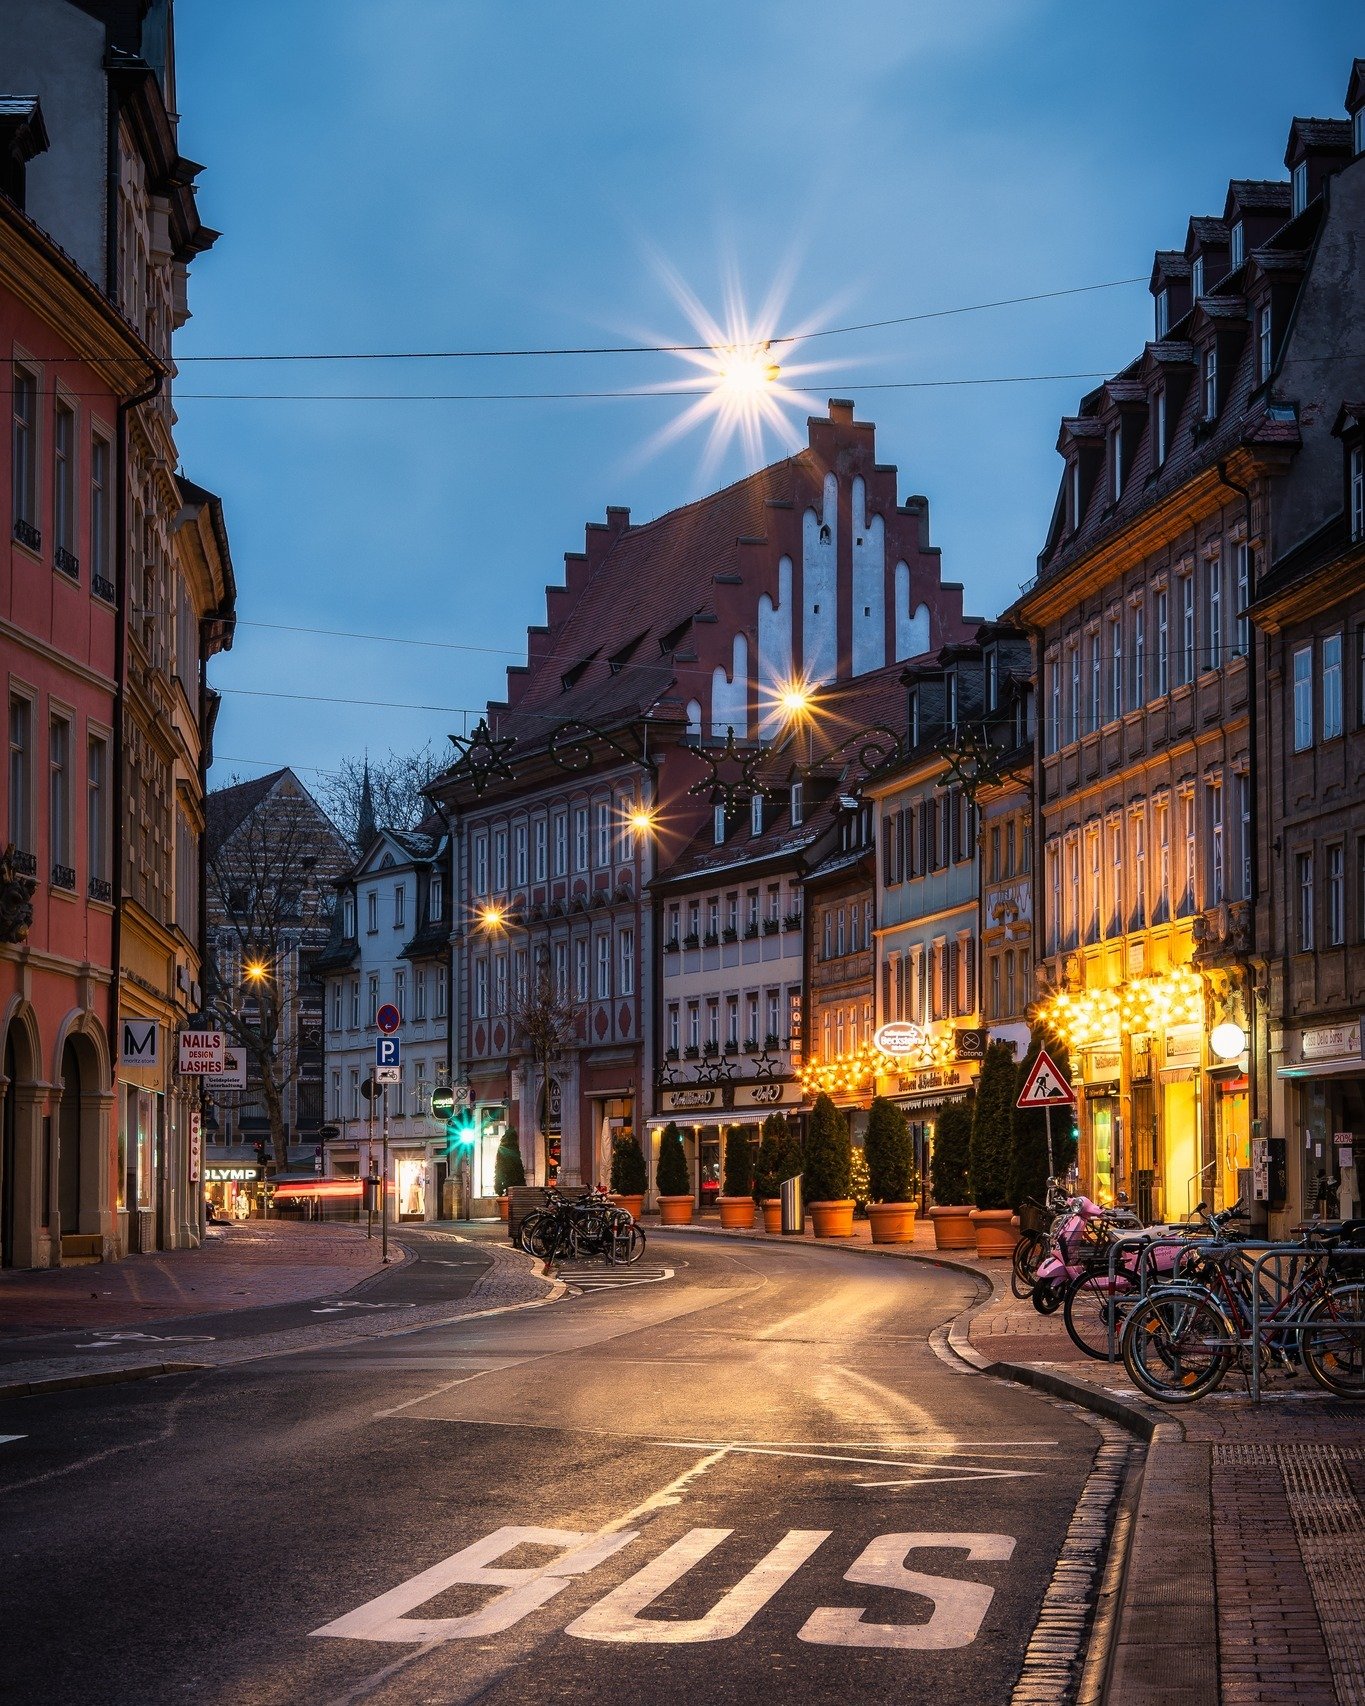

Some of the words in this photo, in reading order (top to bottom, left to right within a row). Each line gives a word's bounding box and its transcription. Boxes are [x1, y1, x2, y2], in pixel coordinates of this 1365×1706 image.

[792, 996, 802, 1065] HOTEL
[182, 1034, 221, 1048] NAILS
[188, 1051, 214, 1059] DESIGN
[381, 1040, 395, 1063] P
[180, 1061, 222, 1073] LASHES
[1334, 1134, 1352, 1143] 20%
[308, 1526, 1017, 1650] BUS
